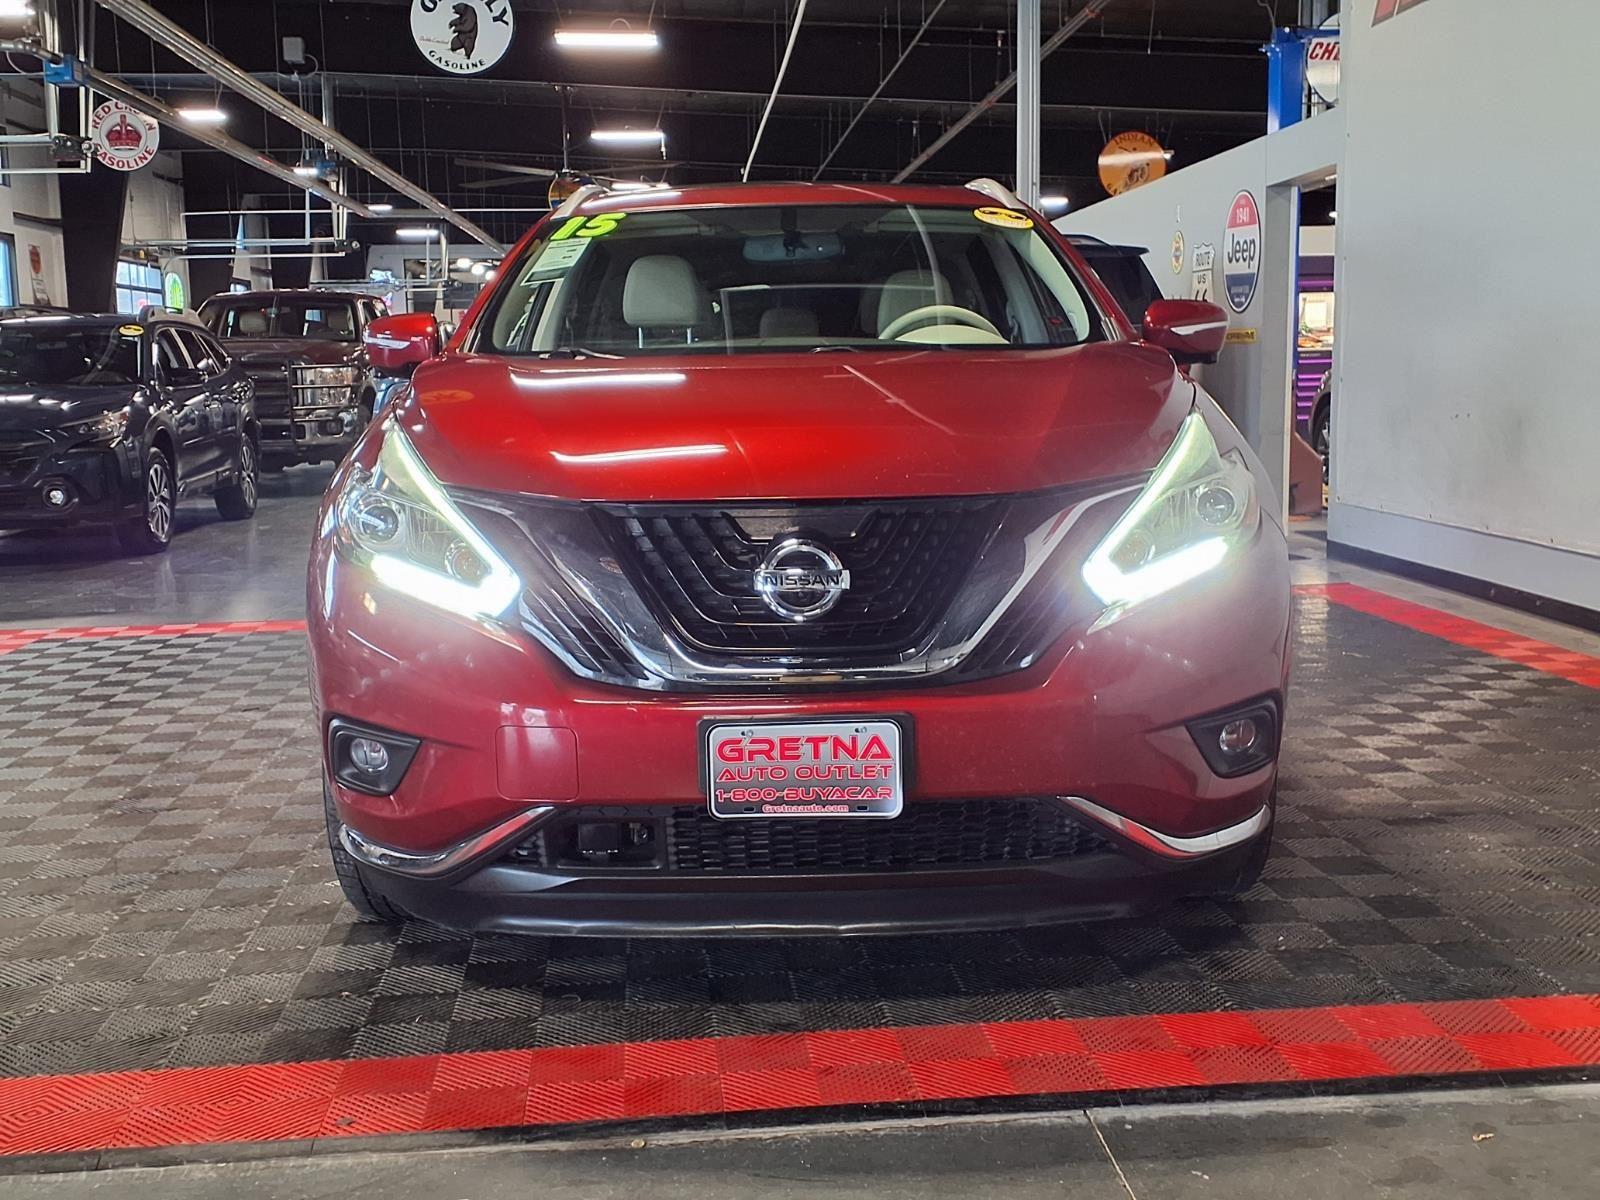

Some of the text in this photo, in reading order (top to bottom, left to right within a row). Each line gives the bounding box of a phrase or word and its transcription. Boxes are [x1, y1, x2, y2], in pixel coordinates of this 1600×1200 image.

[429, 50, 486, 70] GASOLINE
[92, 105, 112, 129] RED
[1114, 133, 1153, 147] INDIAN
[1236, 207, 1250, 224] 1941
[550, 212, 627, 240] 15
[1195, 250, 1211, 267] ROUTE
[1227, 233, 1256, 269] Jeep
[1197, 273, 1207, 284] US
[764, 573, 840, 587] NISSAN
[716, 735, 893, 762] GRETNA
[716, 764, 893, 782] AUTO OUTLET
[716, 786, 893, 802] 1-800-BUYACAR
[762, 804, 849, 814] Gretnaauto.com
